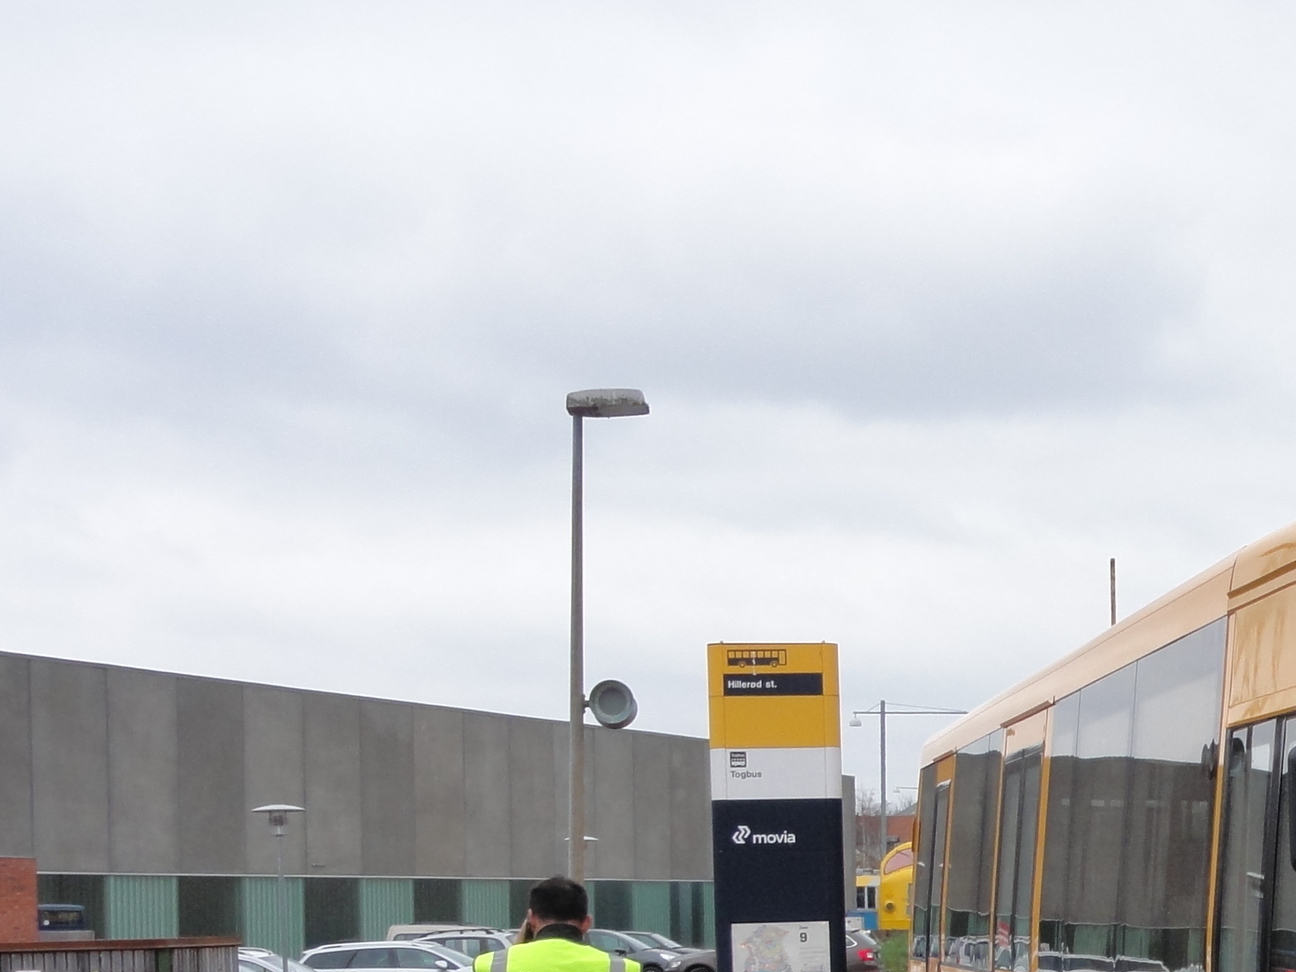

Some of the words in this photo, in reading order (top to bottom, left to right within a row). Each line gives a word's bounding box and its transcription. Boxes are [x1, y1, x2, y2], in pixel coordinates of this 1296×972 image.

[765, 680, 778, 689] st.
[730, 770, 763, 780] Togbus
[752, 830, 797, 844] movia
[799, 932, 808, 943] 9
